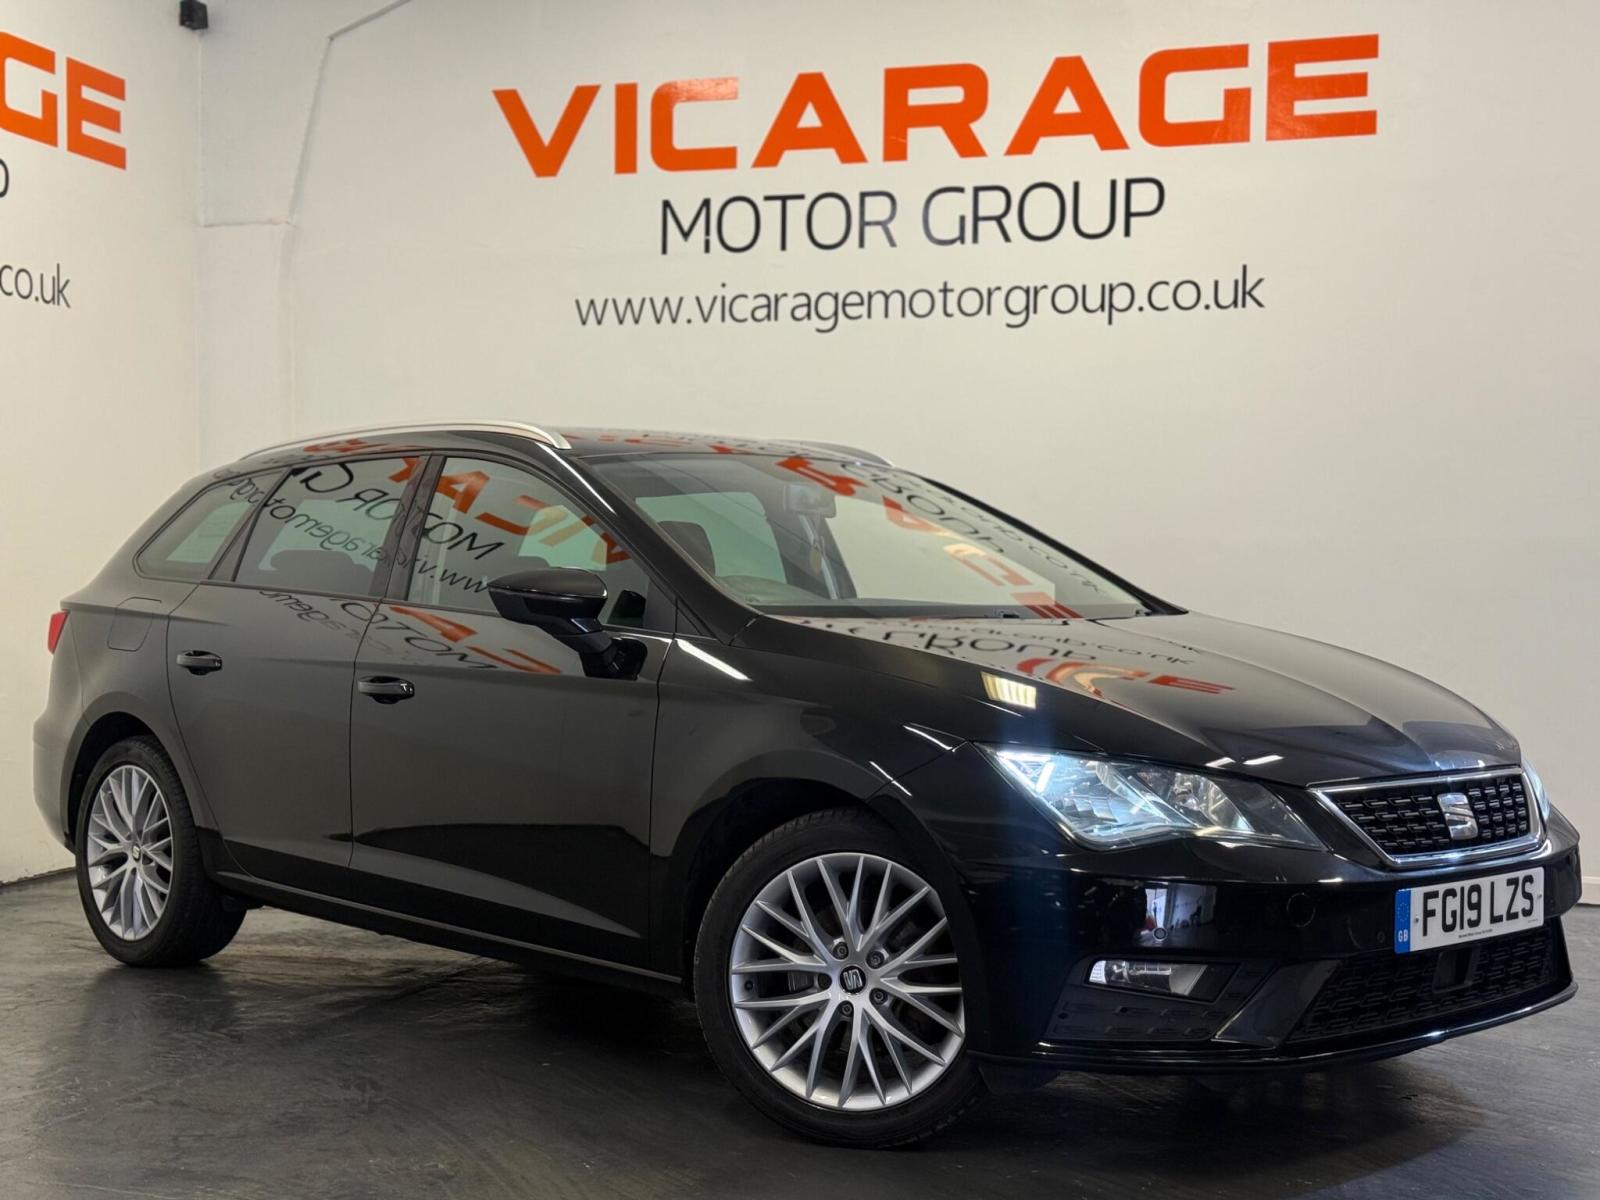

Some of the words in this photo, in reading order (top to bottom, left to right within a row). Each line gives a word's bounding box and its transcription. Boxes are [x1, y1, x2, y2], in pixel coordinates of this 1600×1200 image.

[494, 34, 1379, 178] VICARAGE
[661, 189, 898, 256] MOTOR
[922, 177, 1166, 247] GROUP
[575, 264, 1266, 334] www.vicaragemotorgroup.co.uk
[1397, 928, 1409, 943] GB
[1422, 883, 1482, 937] FG19
[1489, 874, 1534, 925] LZS
